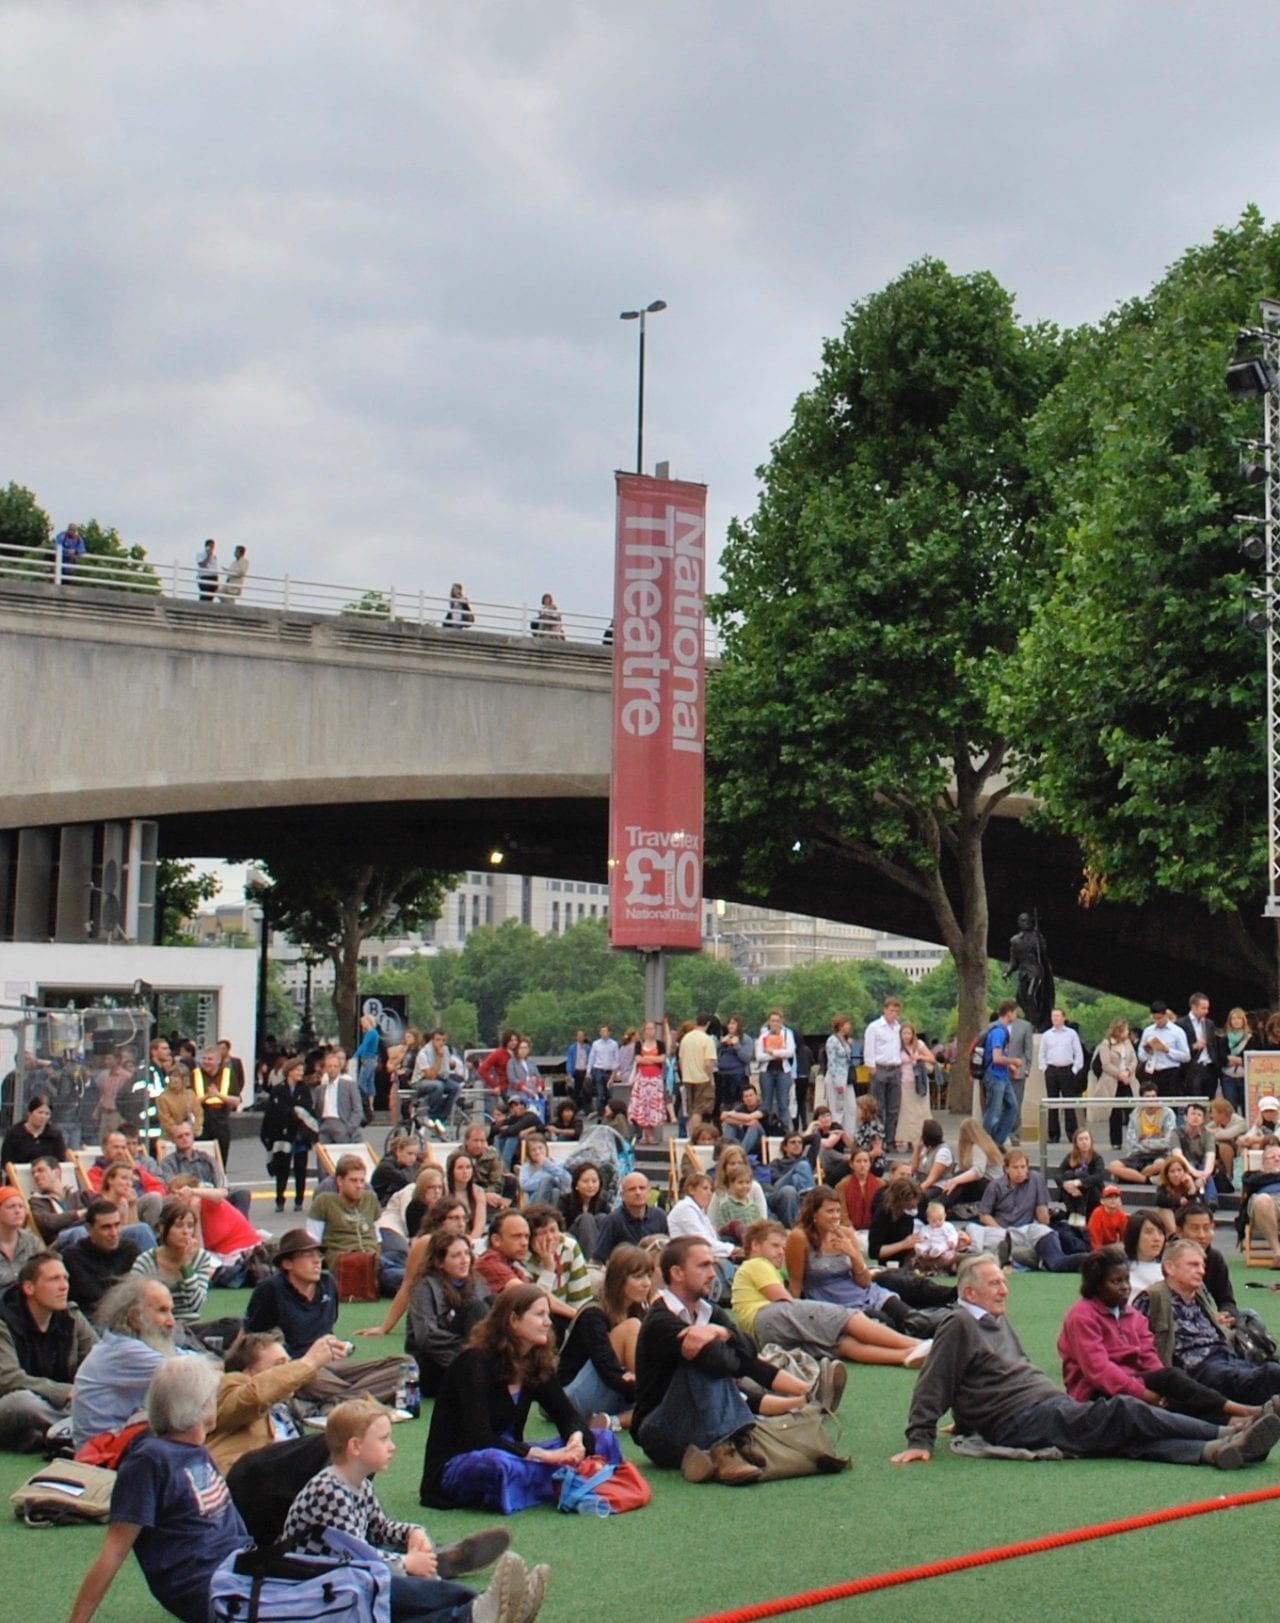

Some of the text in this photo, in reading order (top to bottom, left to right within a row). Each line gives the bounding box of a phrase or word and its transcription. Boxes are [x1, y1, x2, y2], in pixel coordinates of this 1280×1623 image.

[621, 504, 675, 737] Theatre
[672, 511, 704, 754] National
[624, 825, 699, 850] Travelex
[624, 848, 700, 908] £10
